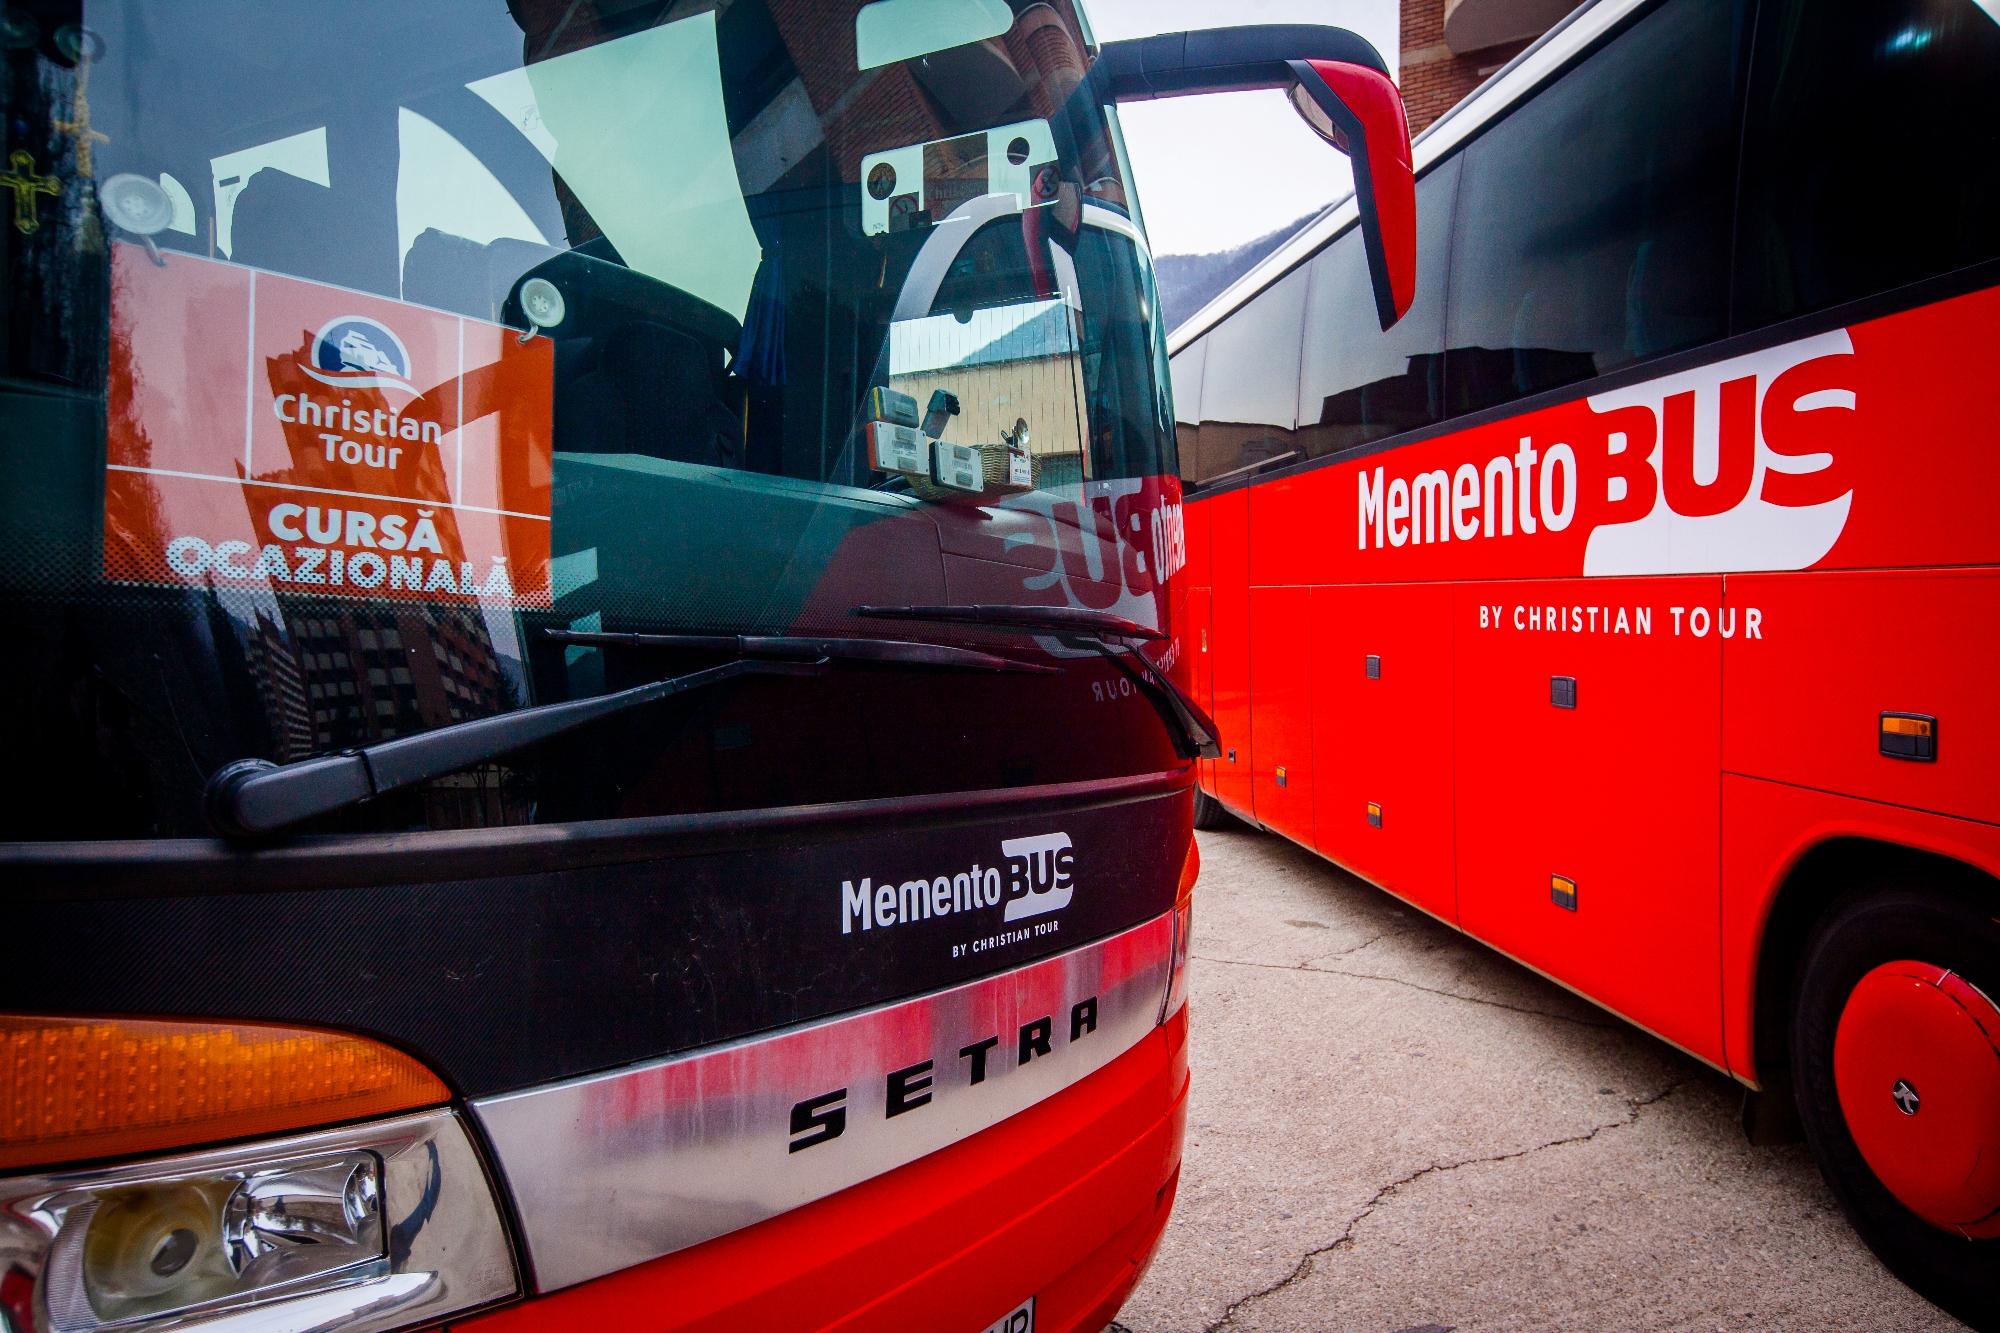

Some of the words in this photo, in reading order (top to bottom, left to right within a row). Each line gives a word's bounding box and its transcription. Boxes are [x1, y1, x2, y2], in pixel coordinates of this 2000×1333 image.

[274, 393, 442, 446] Christian
[318, 433, 403, 470] Tour
[1358, 436, 1577, 550] Memento
[1588, 346, 1857, 520] BUS
[267, 502, 443, 554] CURSĂ
[165, 535, 515, 599] OCAZIONALĂ
[1479, 605, 1502, 629] BY
[1513, 605, 1651, 635] CHRISTIAN
[1669, 606, 1763, 640] TOUR
[842, 863, 1000, 934] Memento
[1001, 842, 1074, 904] BUS
[952, 944, 967, 958] BY
[972, 927, 1031, 953] CHRISTIAN
[1034, 920, 1059, 937] TOUR
[788, 996, 1098, 1154] SETRA
